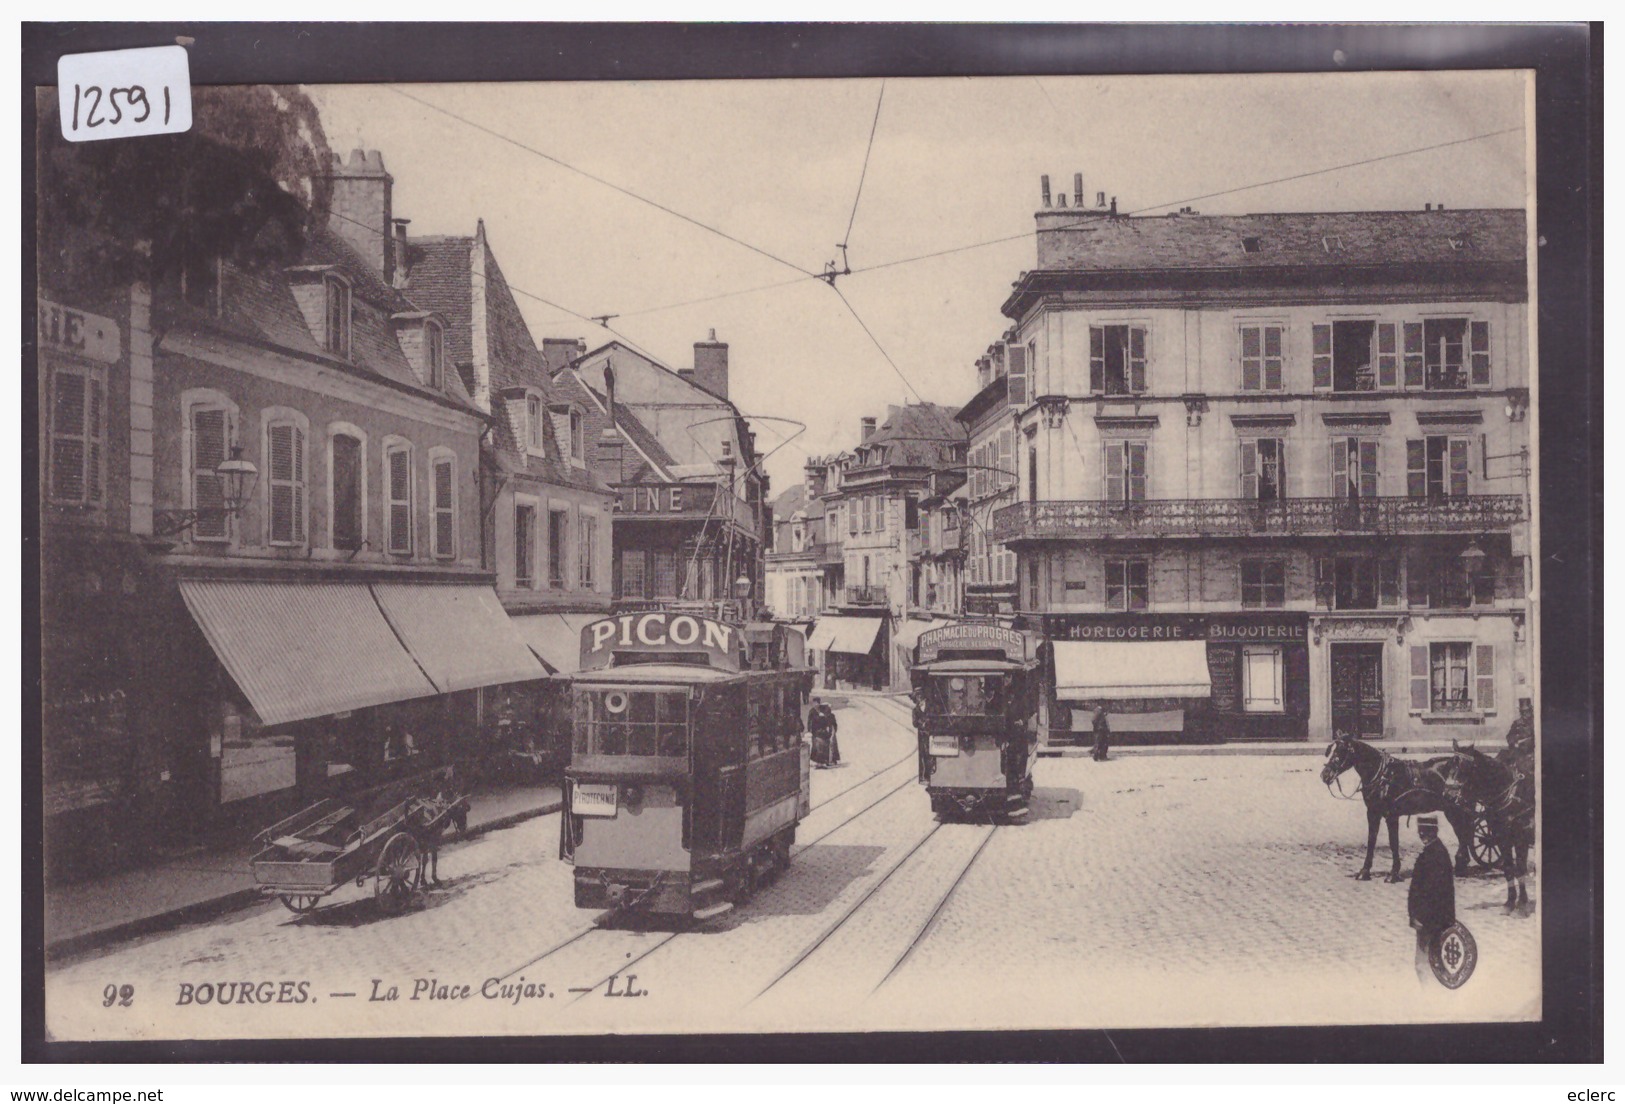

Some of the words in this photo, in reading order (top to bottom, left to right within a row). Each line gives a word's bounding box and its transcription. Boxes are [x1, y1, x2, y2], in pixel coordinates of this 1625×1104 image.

[72, 84, 170, 131] 12591
[591, 613, 732, 655] PICON
[921, 626, 968, 648] PHARMACIE
[1070, 625, 1183, 638] HORLOGERIE
[1210, 624, 1303, 637] BIJOUTERIE
[102, 983, 135, 1007] 92
[175, 981, 318, 1006] BOURGES.
[368, 979, 400, 1002] La
[409, 978, 471, 1001] Place
[481, 976, 555, 1005] Cujas.
